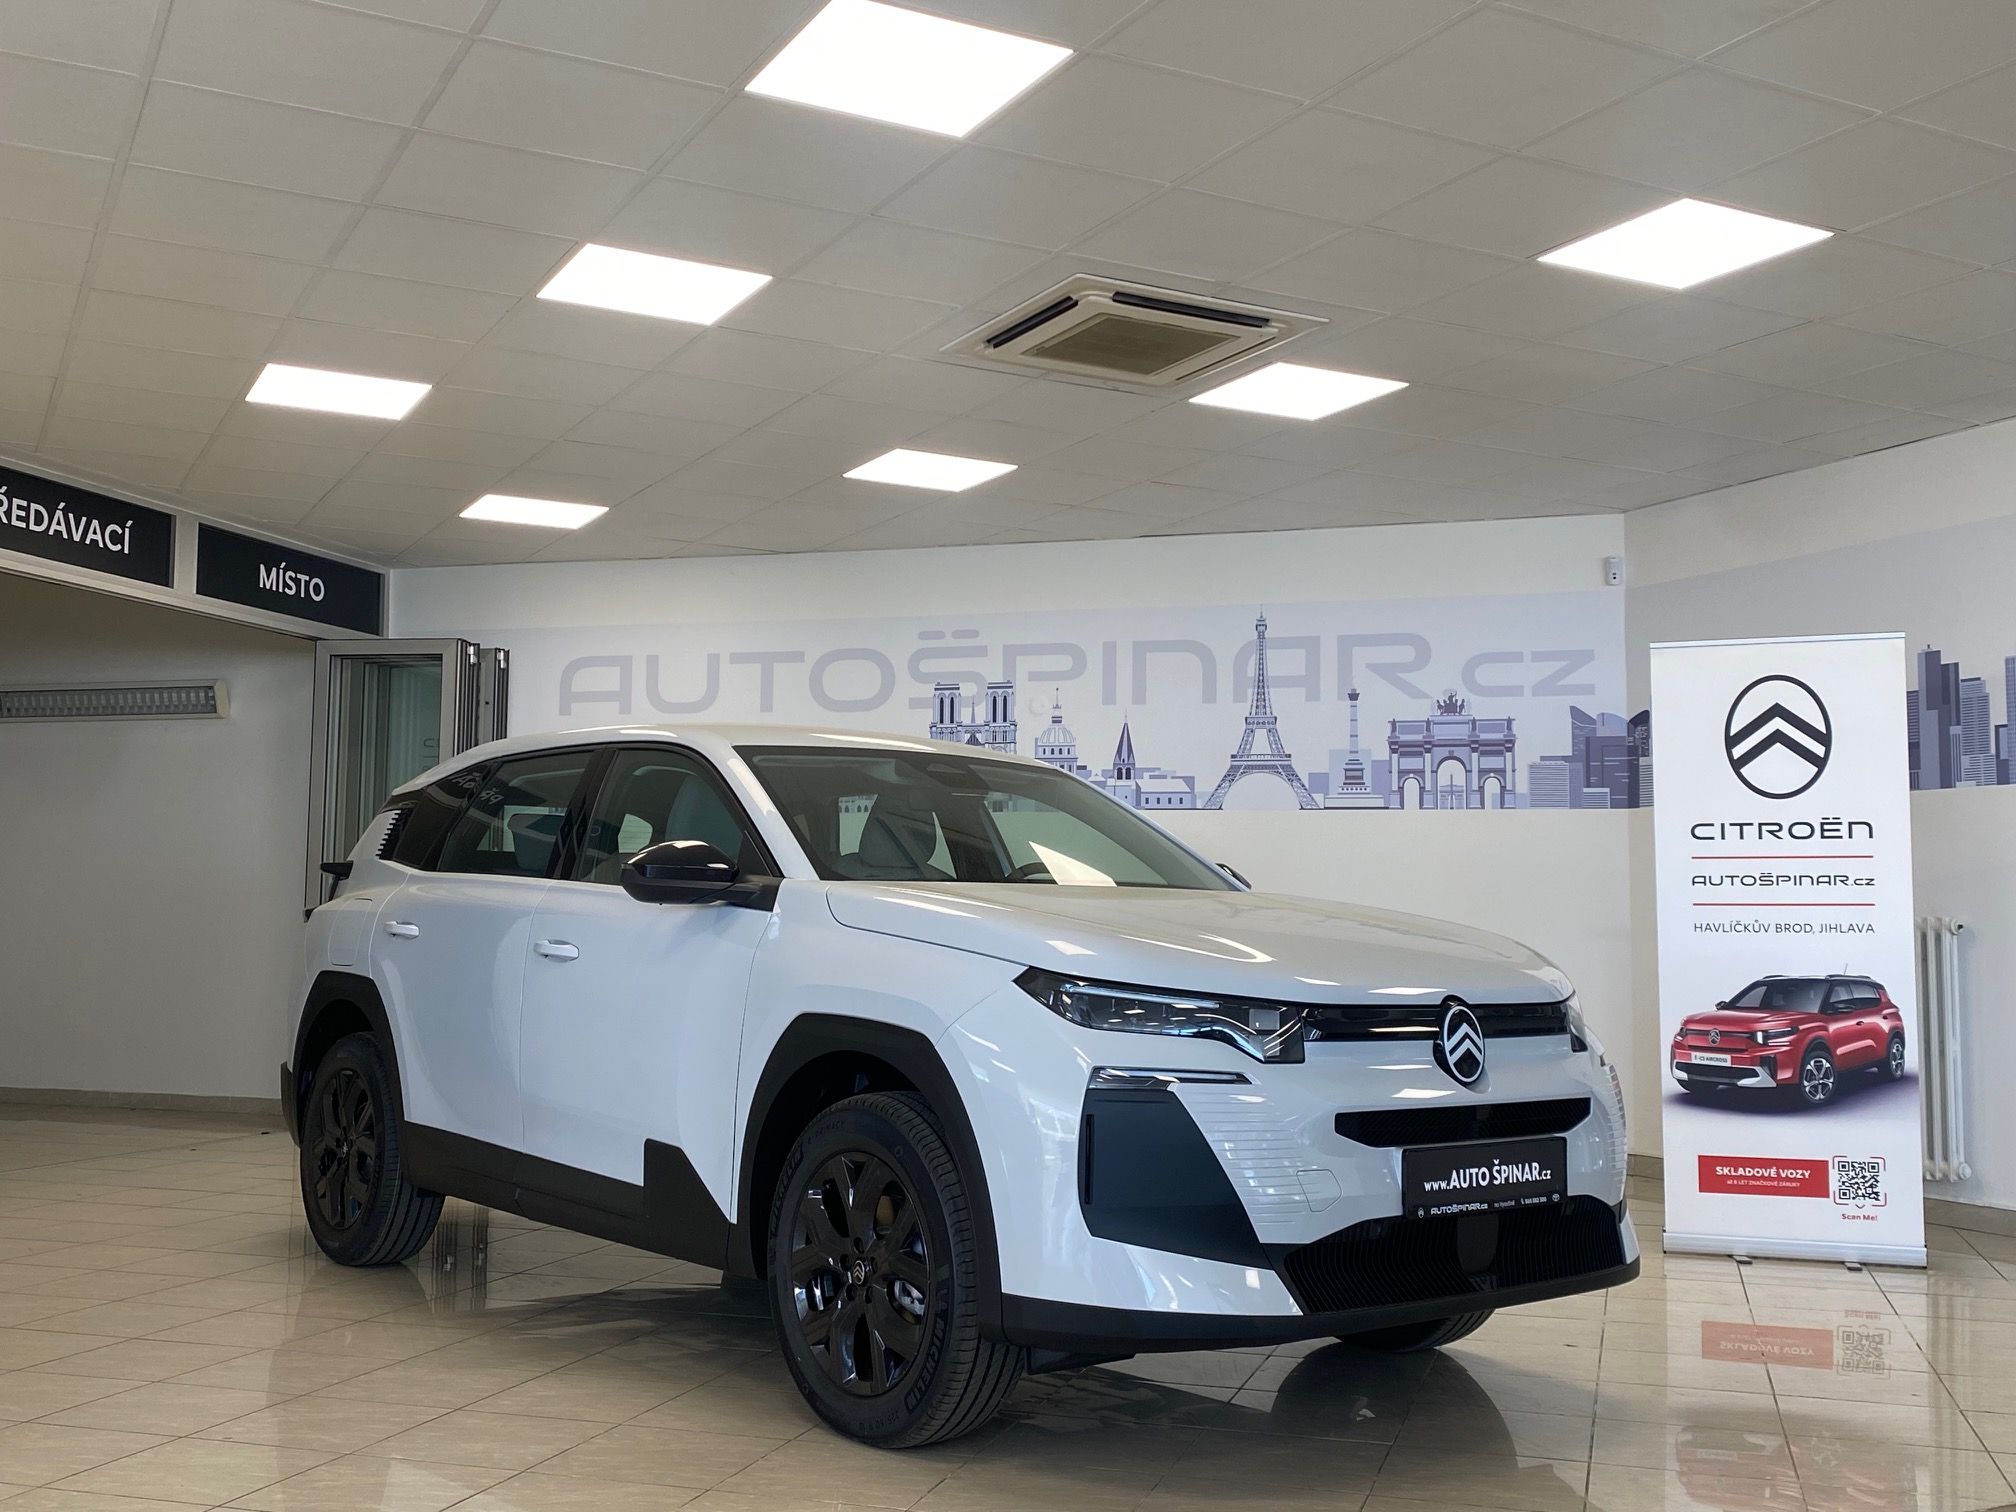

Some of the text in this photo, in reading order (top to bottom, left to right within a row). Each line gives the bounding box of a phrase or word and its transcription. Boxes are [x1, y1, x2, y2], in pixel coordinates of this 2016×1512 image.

[258, 562, 326, 602] MÍSTO
[1690, 816, 1874, 841] CITROËN
[1694, 919, 1876, 936] HAVLÍČKŮV BROD, JIHLAVA
[1424, 1158, 1552, 1192] www.AUTO ŠPINAR.cz
[1715, 1166, 1811, 1179] SKLADOVÉ VOZY
